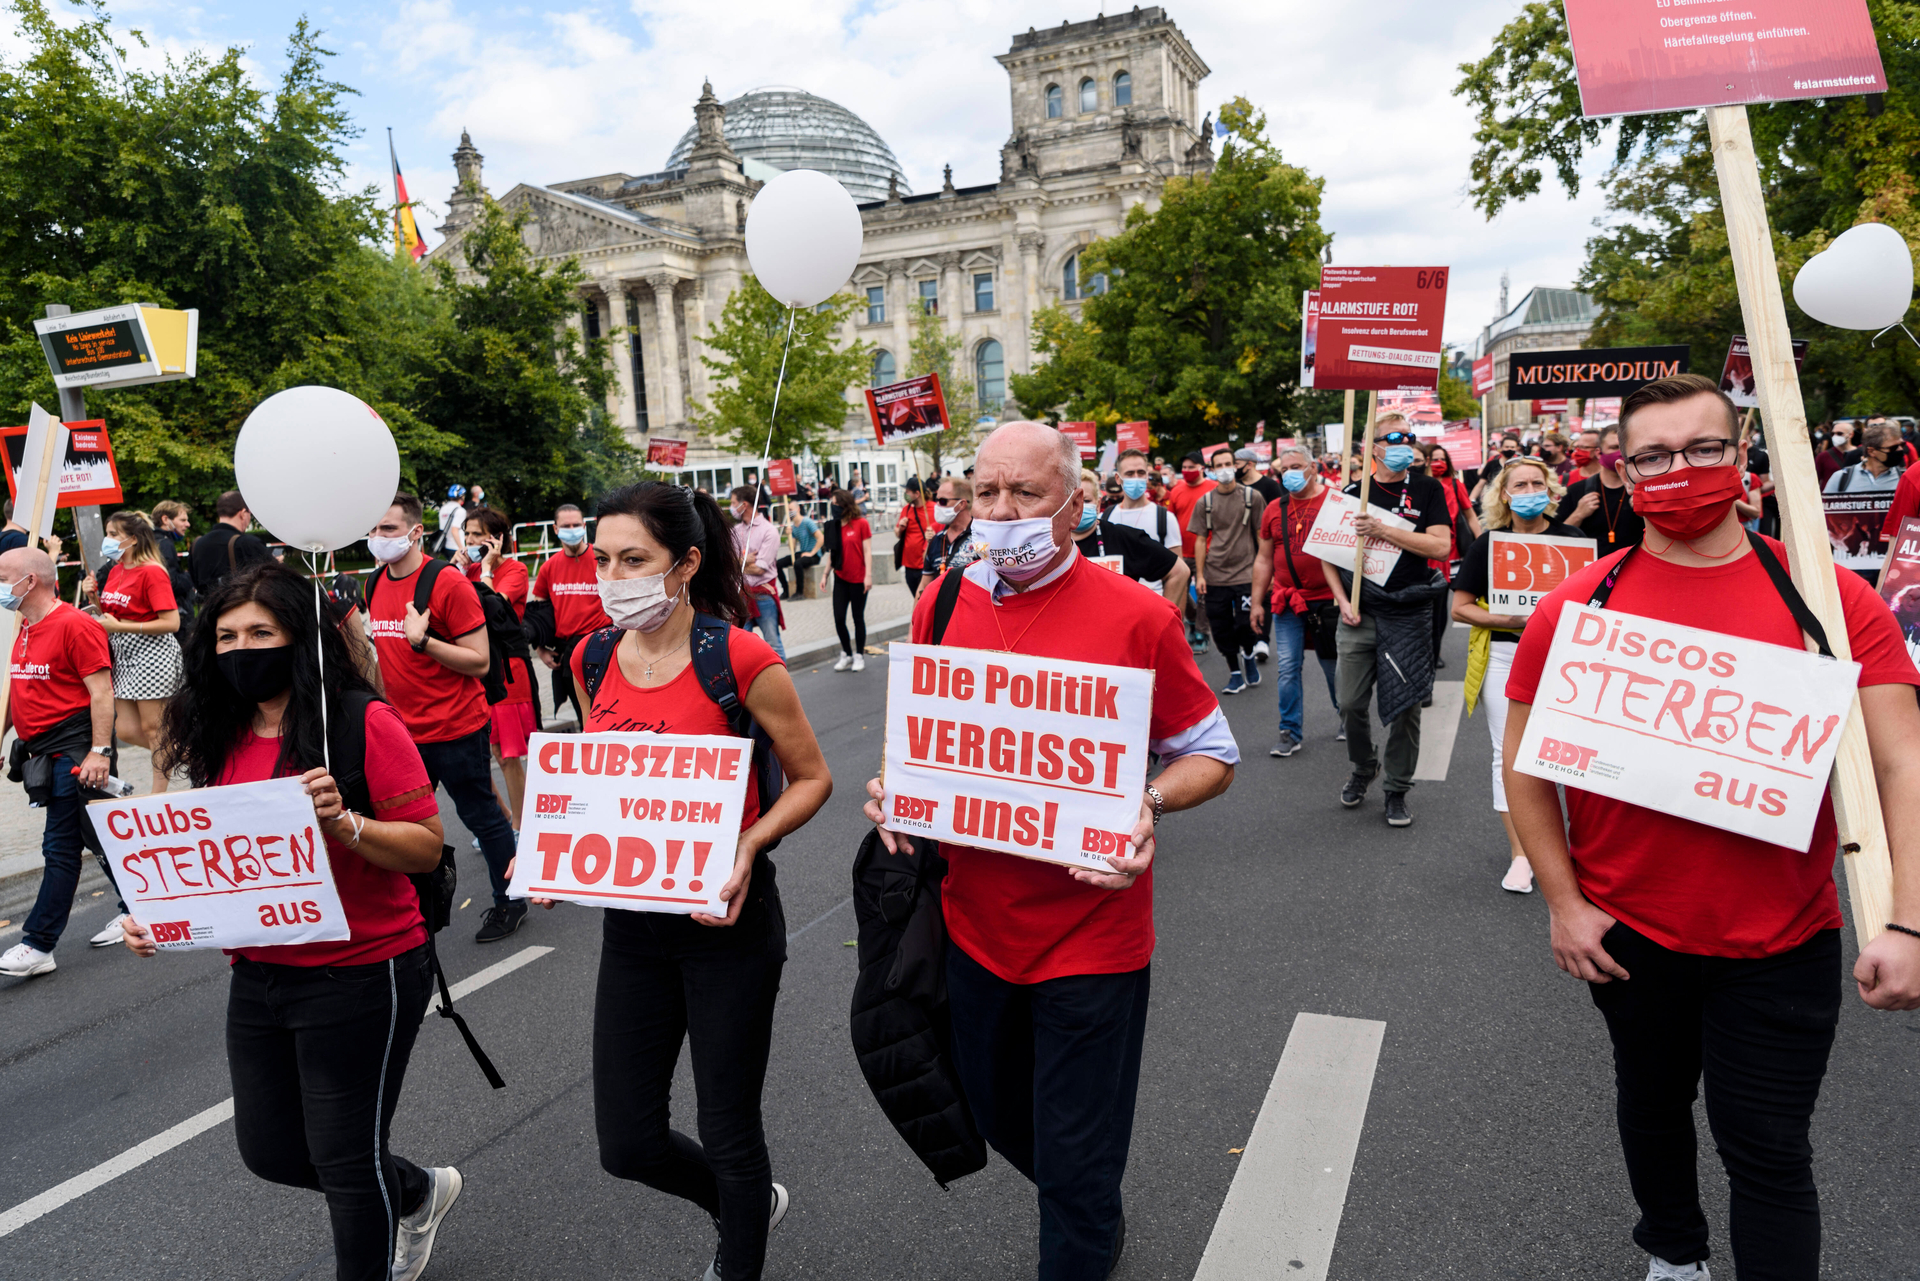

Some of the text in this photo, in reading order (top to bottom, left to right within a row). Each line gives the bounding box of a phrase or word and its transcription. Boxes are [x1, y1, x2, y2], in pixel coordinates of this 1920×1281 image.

[1660, 10, 1756, 28] Obergrenze öffnen.
[1664, 25, 1810, 48] Härtefallregelung einführen.
[1794, 74, 1876, 90] #alarmstuferot
[1416, 270, 1445, 290] 6/6
[1320, 301, 1418, 316] ALARMSTUFE ROT!
[1342, 327, 1428, 336] Insolvenz durch Berufsverbot
[1352, 348, 1436, 364] RETTUNGS-DIALOG JETZT!
[1516, 360, 1680, 385] MUSIKPODIUM
[76, 472, 92, 482] ROT!
[1644, 480, 1689, 492] #alarmstuferot
[990, 548, 1018, 557] STERNE
[991, 550, 1036, 567] SPORTS
[1492, 594, 1538, 606] IM DE
[1571, 612, 1737, 678] Discos
[912, 655, 1120, 720] Die Politik
[1556, 661, 1840, 765] STERBEN
[538, 742, 742, 781] CLUBSZENE
[906, 714, 1126, 790] VERGISST
[1538, 736, 1598, 772] BDT
[1548, 763, 1586, 778] DEHOGA
[536, 794, 572, 814] BDT
[1694, 770, 1788, 817] aus
[620, 798, 723, 824] VOR DEM
[894, 794, 939, 823] BDT
[107, 804, 212, 840] Clubs
[903, 819, 932, 829] DEHOGA
[952, 795, 1059, 850] uns!
[1082, 826, 1132, 858] BDT
[122, 826, 315, 894] STERBEN
[536, 832, 713, 893] TOD!!
[1091, 854, 1107, 862] DEH
[258, 901, 322, 928] aus
[150, 920, 191, 943] BDT
